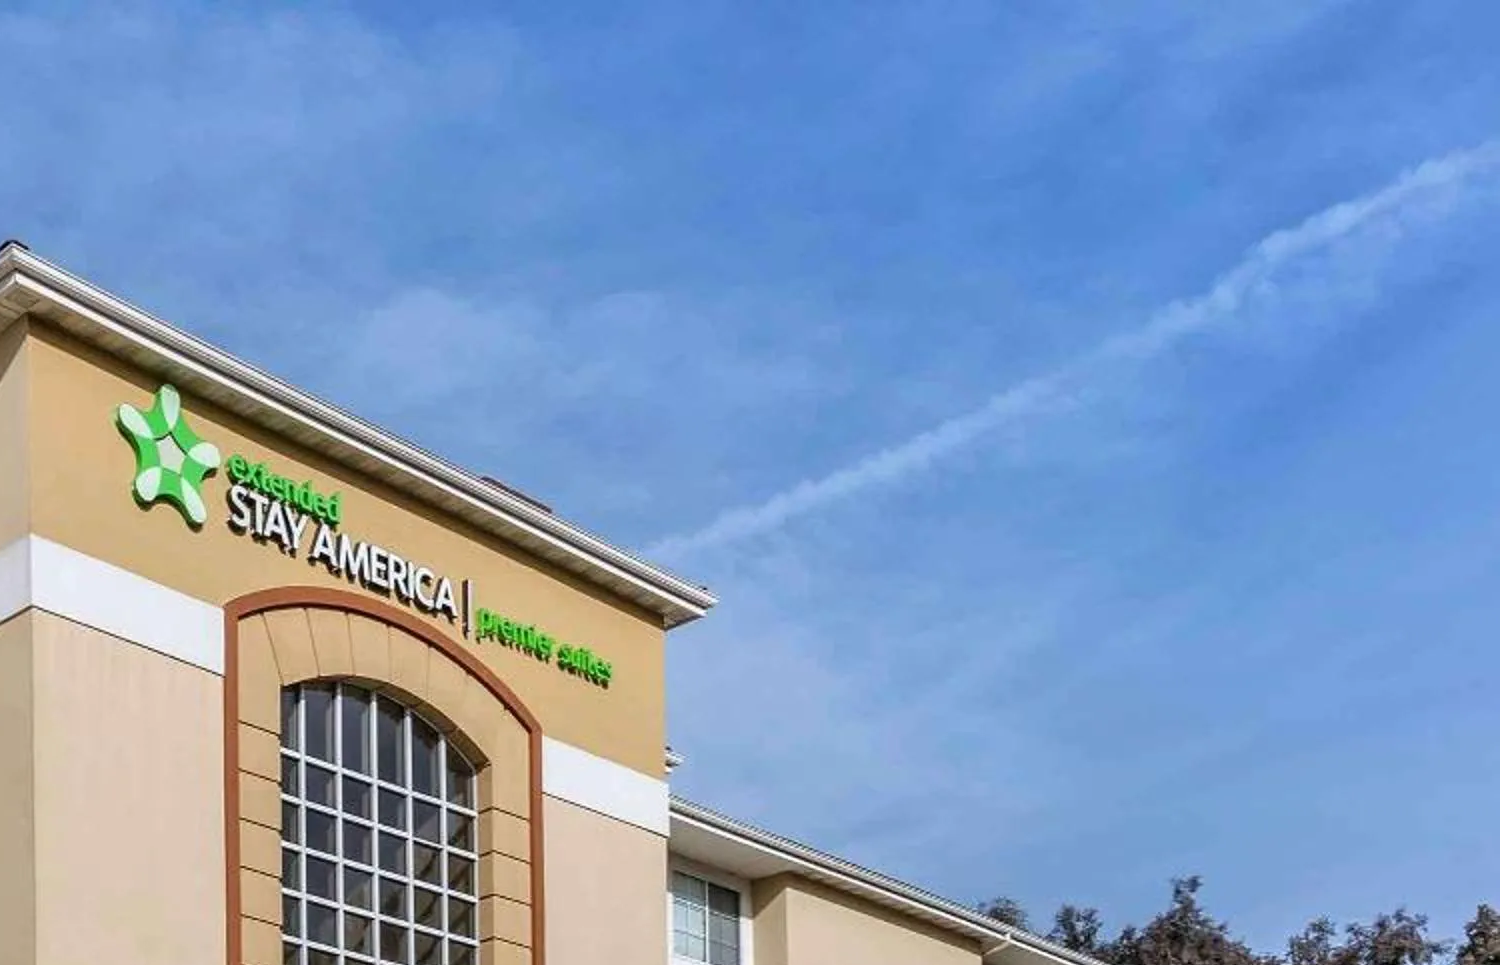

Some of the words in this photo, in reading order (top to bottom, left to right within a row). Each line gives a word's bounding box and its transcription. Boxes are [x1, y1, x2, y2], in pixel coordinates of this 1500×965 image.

[227, 454, 341, 524] extended
[228, 484, 308, 552] STAY
[311, 522, 458, 620] AMERICA
[476, 607, 556, 657] premier
[557, 642, 613, 684] suites
